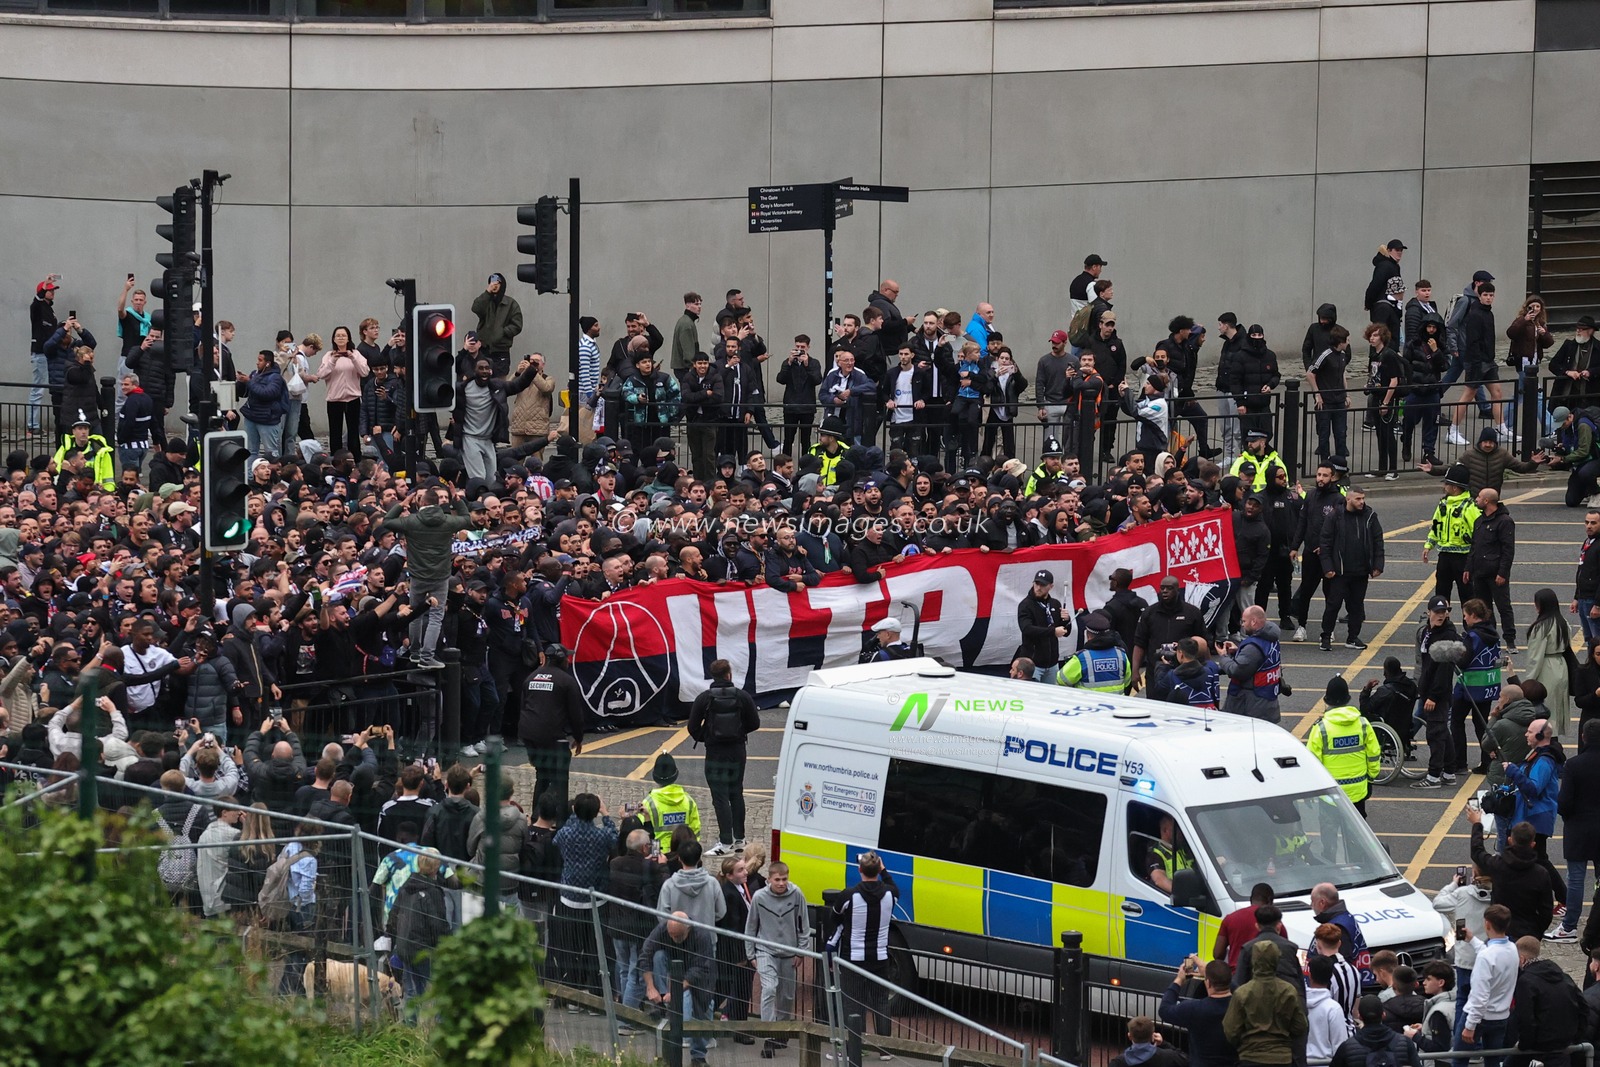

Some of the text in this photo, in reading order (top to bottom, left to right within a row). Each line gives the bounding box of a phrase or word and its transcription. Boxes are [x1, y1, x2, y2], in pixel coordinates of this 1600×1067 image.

[533, 482, 553, 500] 10
[1096, 663, 1116, 671] POLICE
[1487, 671, 1496, 683] TV
[1484, 686, 1498, 699] 267
[1334, 736, 1359, 747] POLICE
[1003, 735, 1119, 776] POLICE
[803, 761, 879, 781] www.northumbria.police.uk
[1124, 759, 1144, 775] Y53
[834, 786, 858, 797] Emergency
[865, 792, 876, 800] 101
[823, 798, 875, 814] Emergency 999
[663, 814, 686, 824] POLICE
[1353, 908, 1416, 924] OLICE
